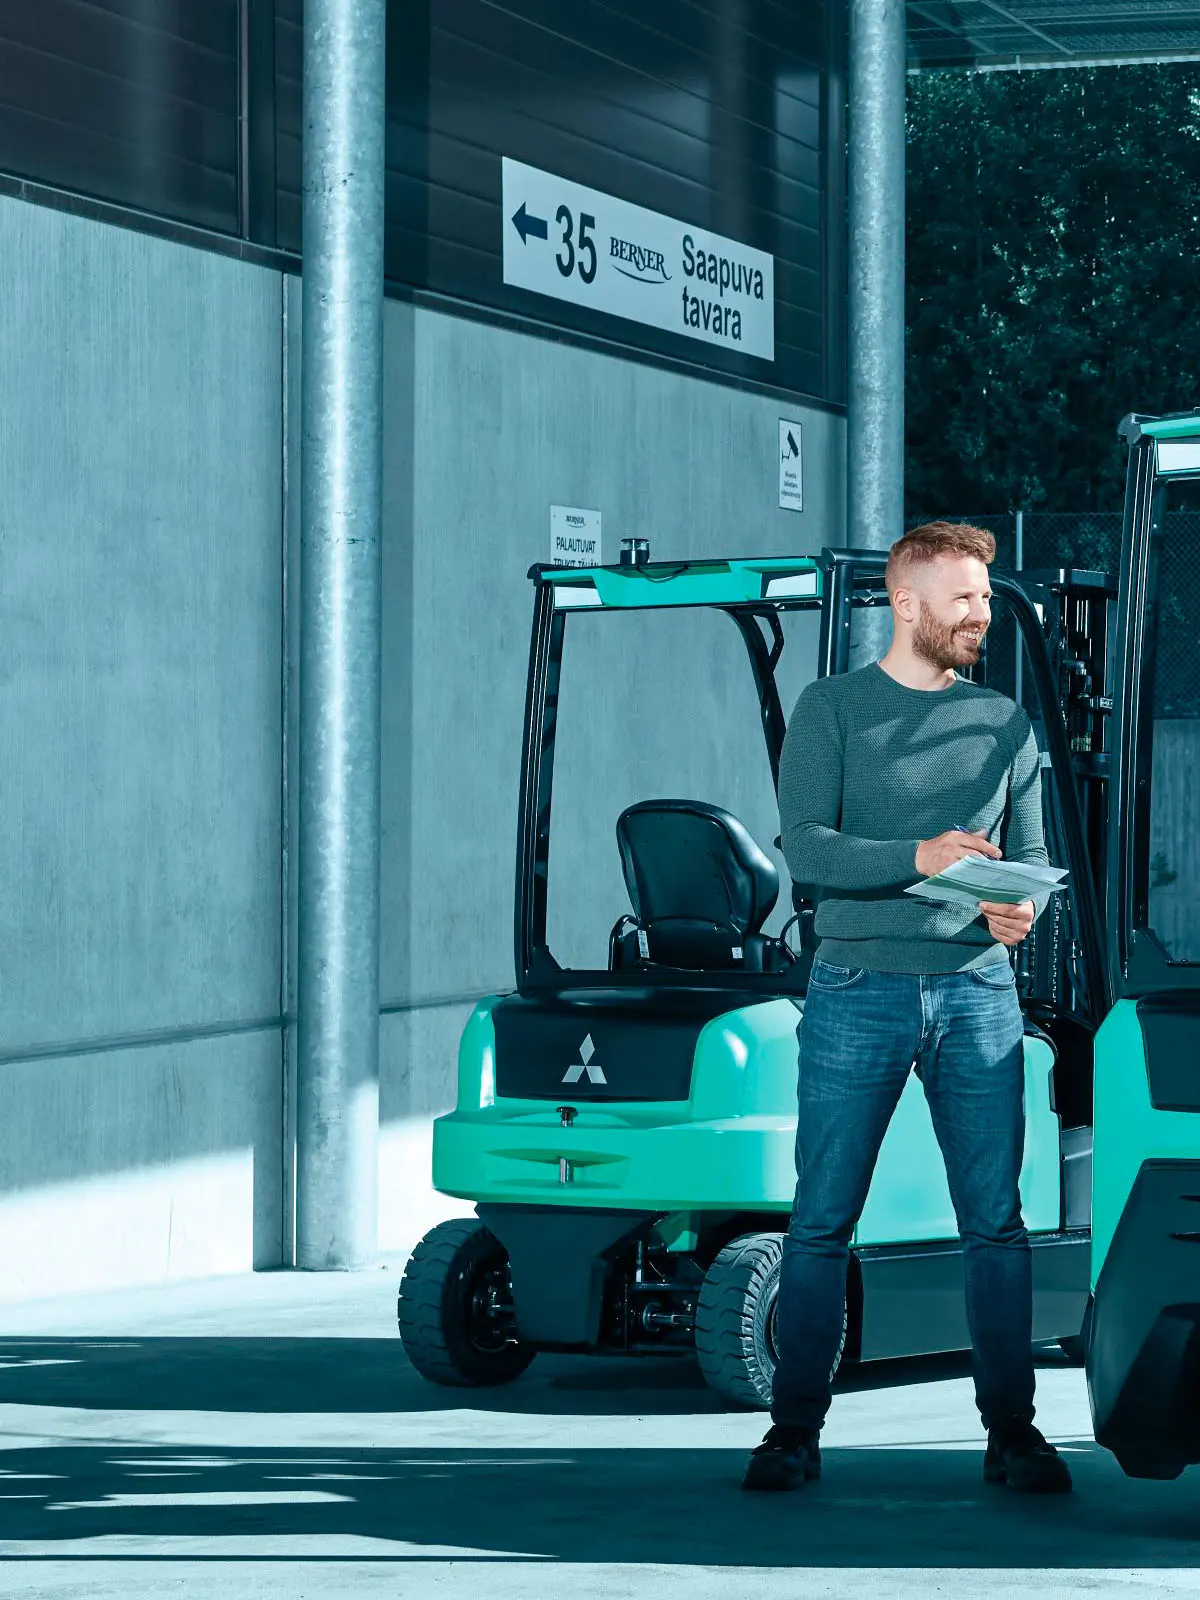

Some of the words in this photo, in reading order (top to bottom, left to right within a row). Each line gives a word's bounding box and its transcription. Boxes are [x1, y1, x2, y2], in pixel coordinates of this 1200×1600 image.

[555, 204, 597, 284] 35
[609, 236, 672, 281] BERNER
[682, 234, 764, 300] Saapuva
[682, 286, 742, 341] tavara
[556, 537, 596, 553] PALAUTUVAT
